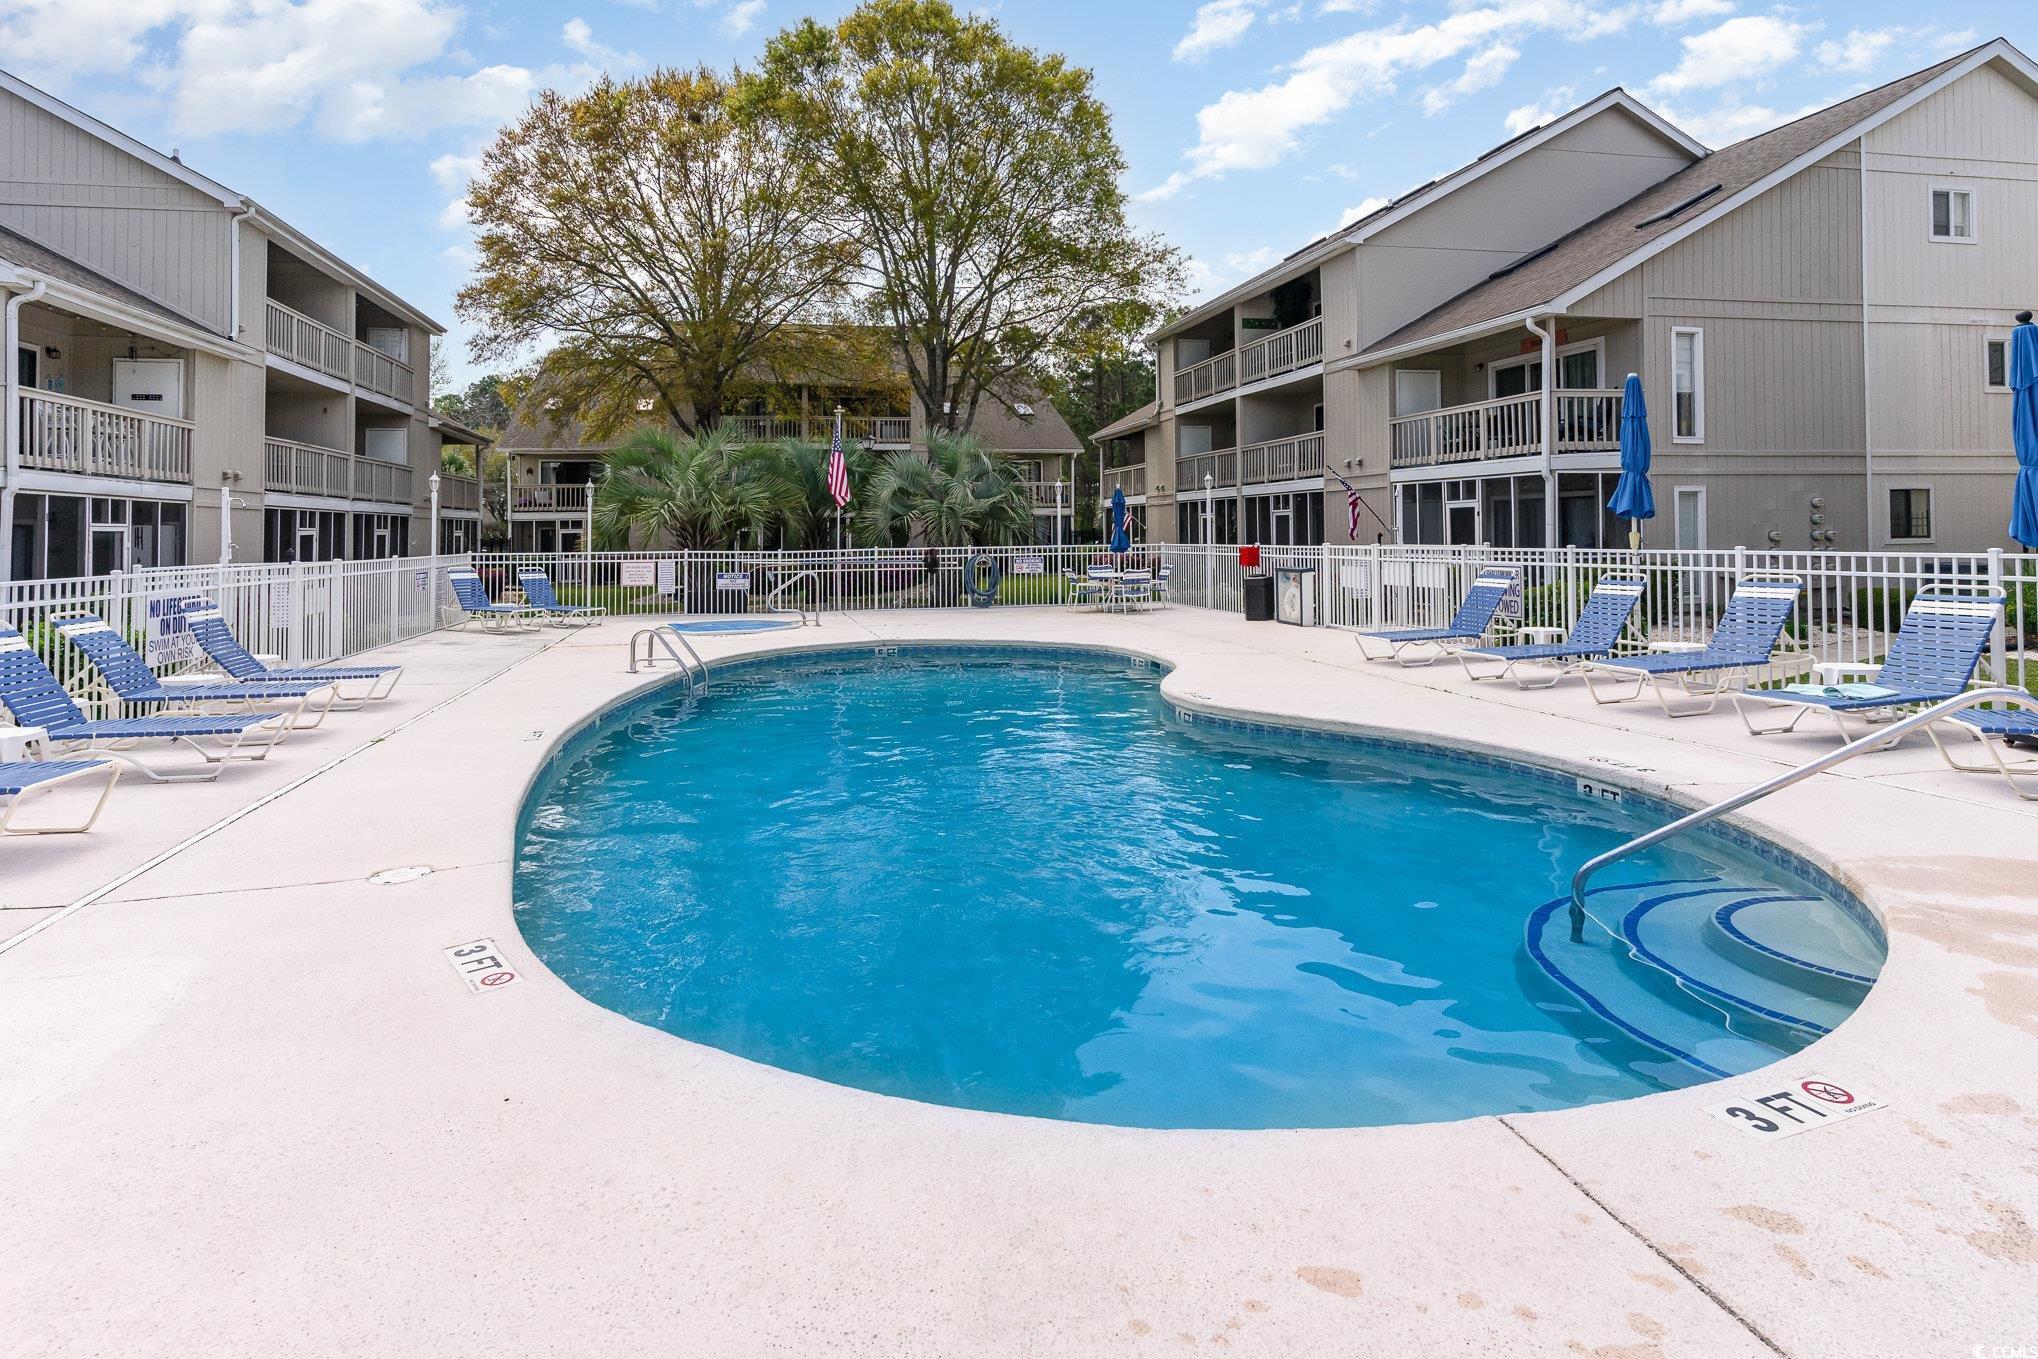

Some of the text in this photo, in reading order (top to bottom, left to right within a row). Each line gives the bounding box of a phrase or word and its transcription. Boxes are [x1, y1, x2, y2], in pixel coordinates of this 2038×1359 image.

[149, 600, 160, 618] NO
[1499, 600, 1519, 614] OWED
[161, 614, 191, 636] ON DUT
[149, 634, 196, 653] SWIM AT YOU
[158, 646, 194, 664] OWN RISK
[453, 945, 503, 974] 3 FT
[1725, 1091, 1828, 1132] 3 FT
